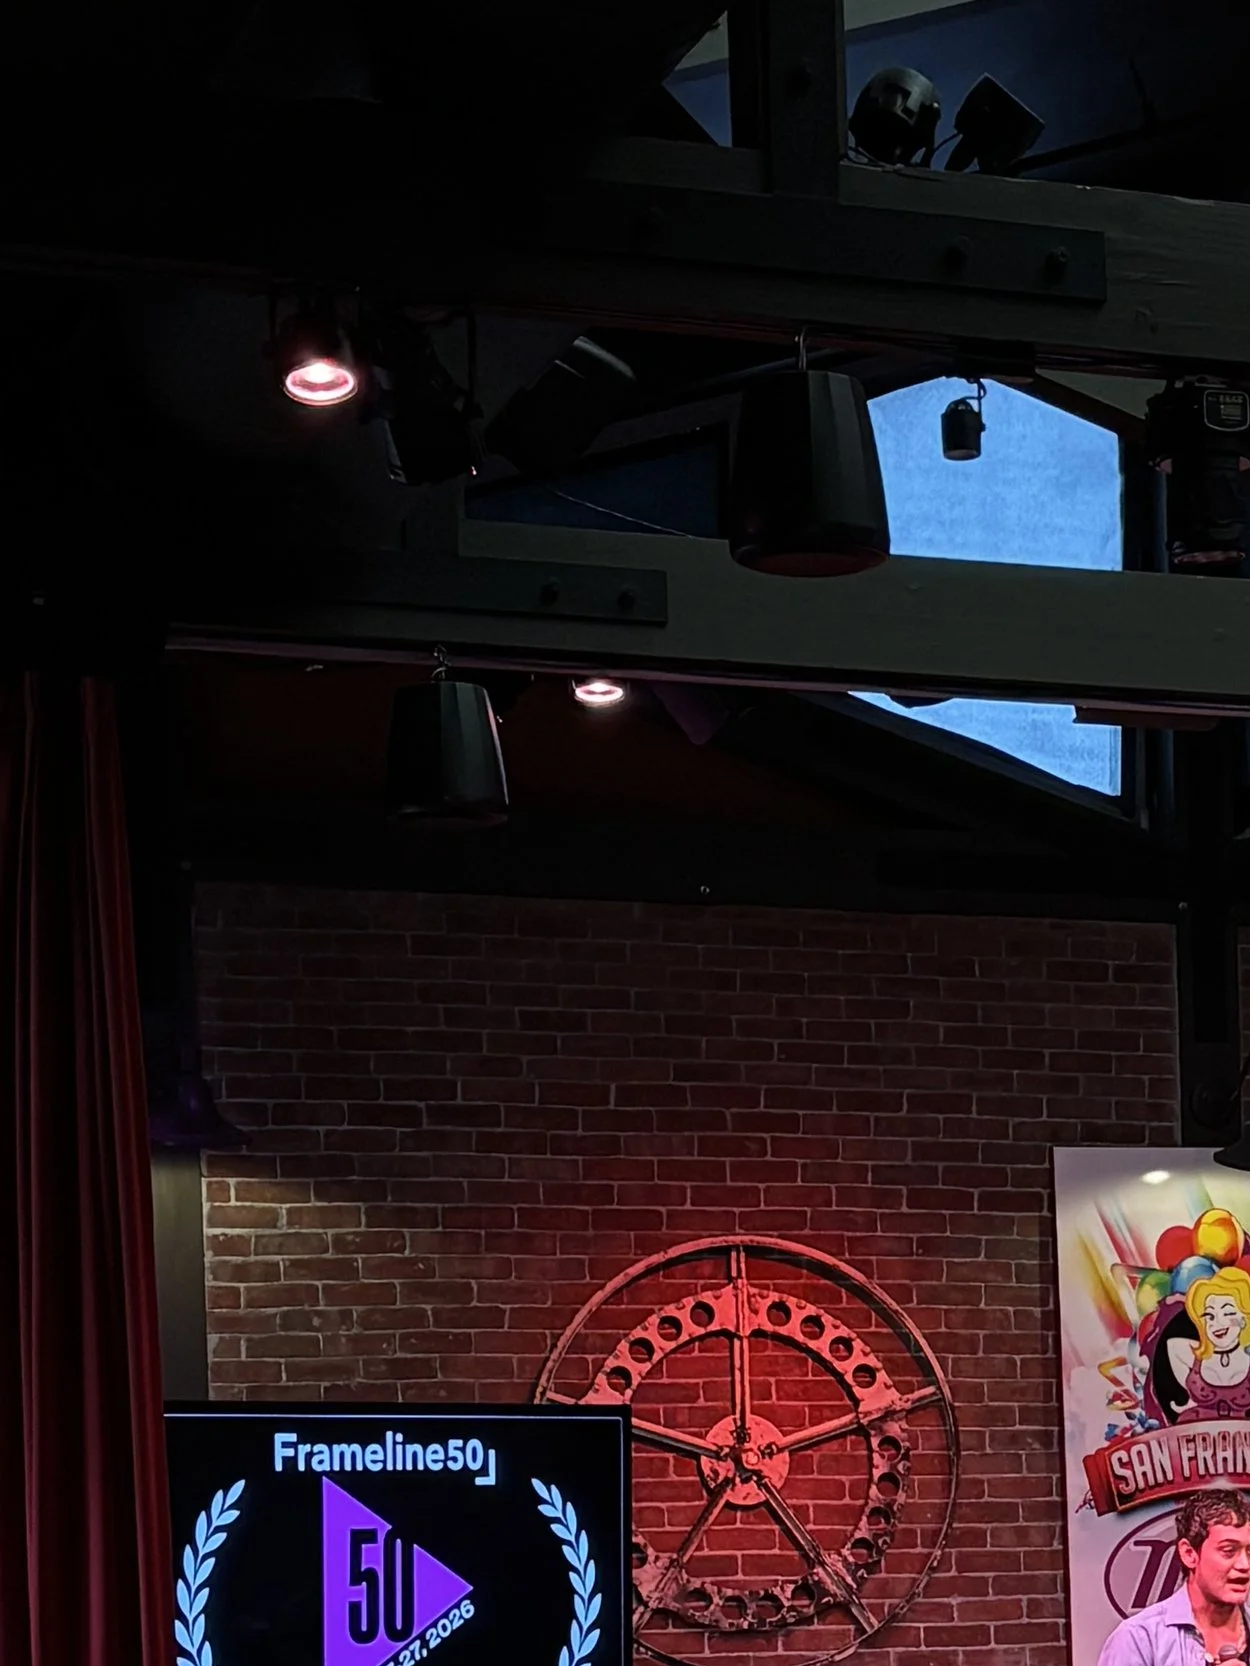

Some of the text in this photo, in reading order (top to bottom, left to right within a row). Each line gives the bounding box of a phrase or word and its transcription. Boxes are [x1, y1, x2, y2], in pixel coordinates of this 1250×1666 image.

[274, 1432, 484, 1473] Frameline50
[1110, 1438, 1173, 1494] SAN
[347, 1528, 416, 1645] 50
[425, 1599, 475, 1649] 2026
